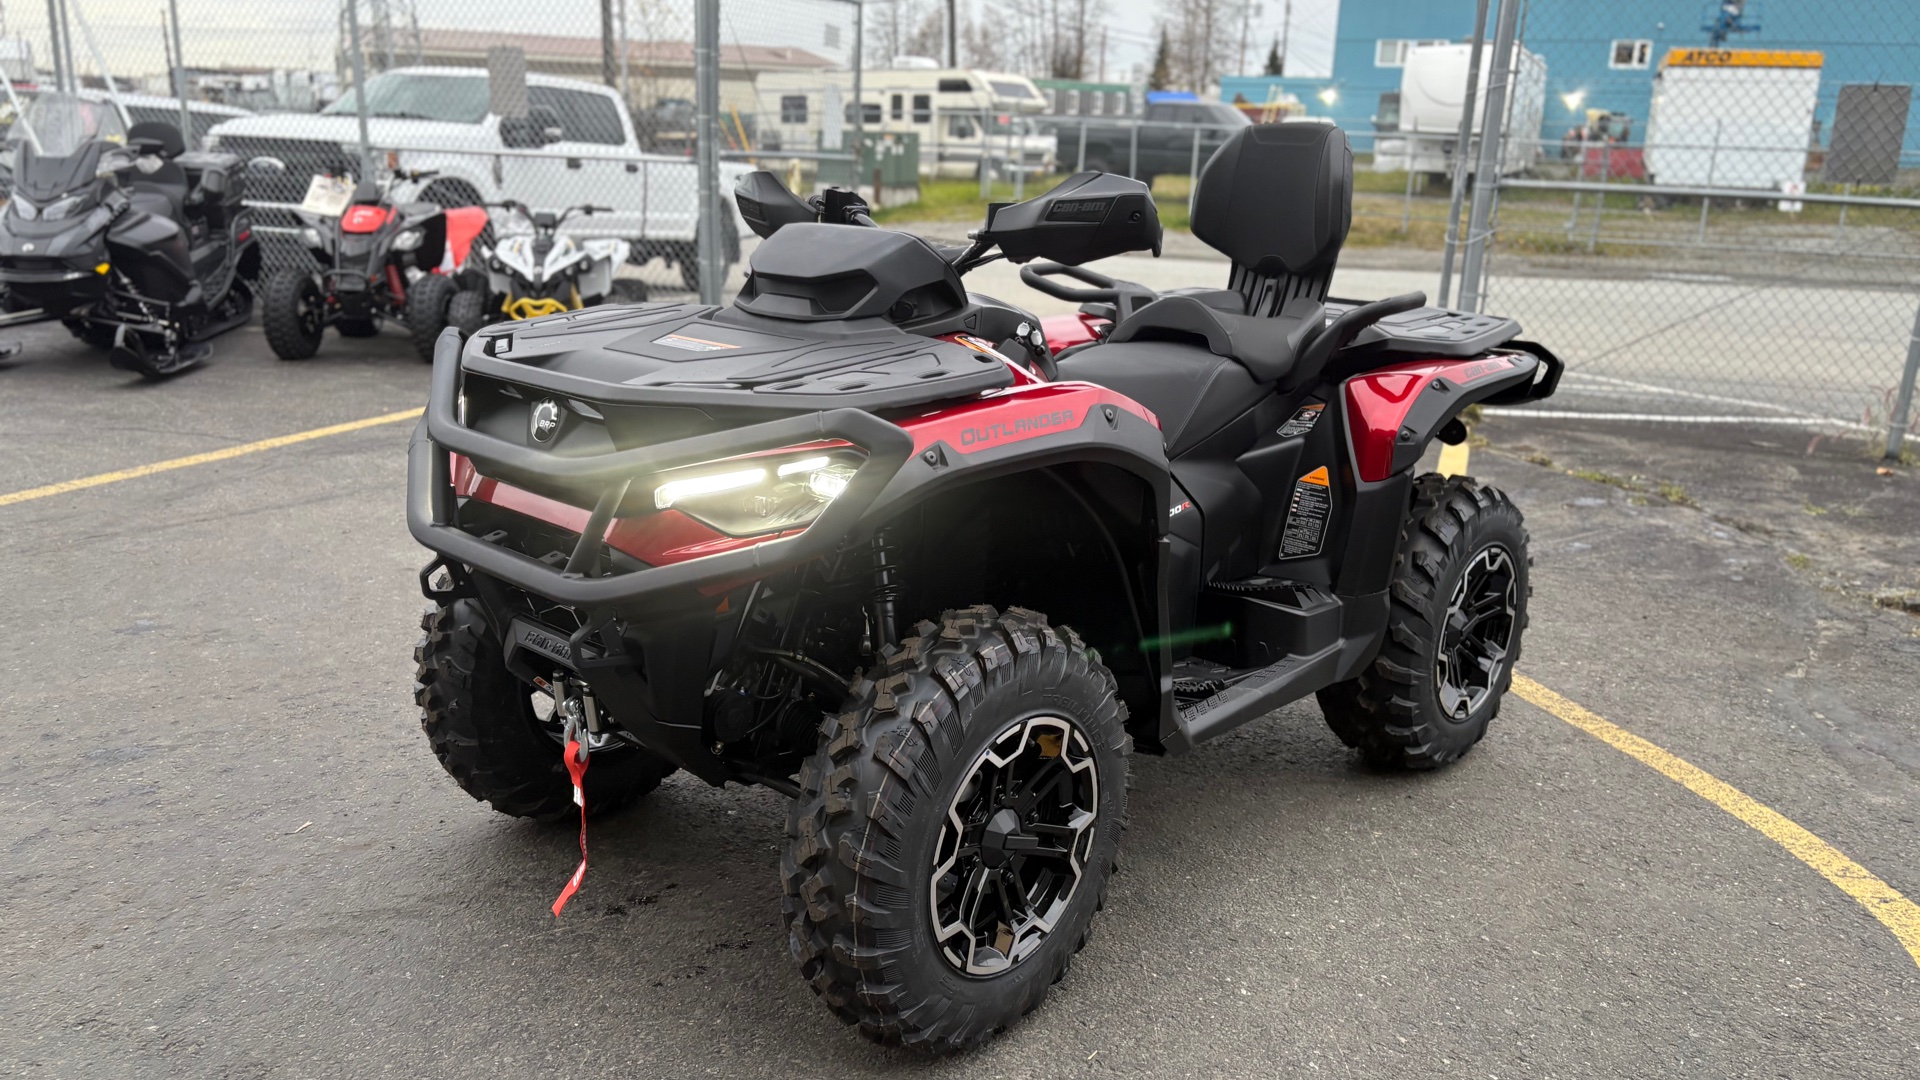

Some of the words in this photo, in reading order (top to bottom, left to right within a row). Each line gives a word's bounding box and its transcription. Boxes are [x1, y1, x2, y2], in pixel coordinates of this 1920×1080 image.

[1682, 50, 1732, 64] ATCO
[539, 419, 556, 430] BRP
[961, 410, 1075, 446] OUTLANDER
